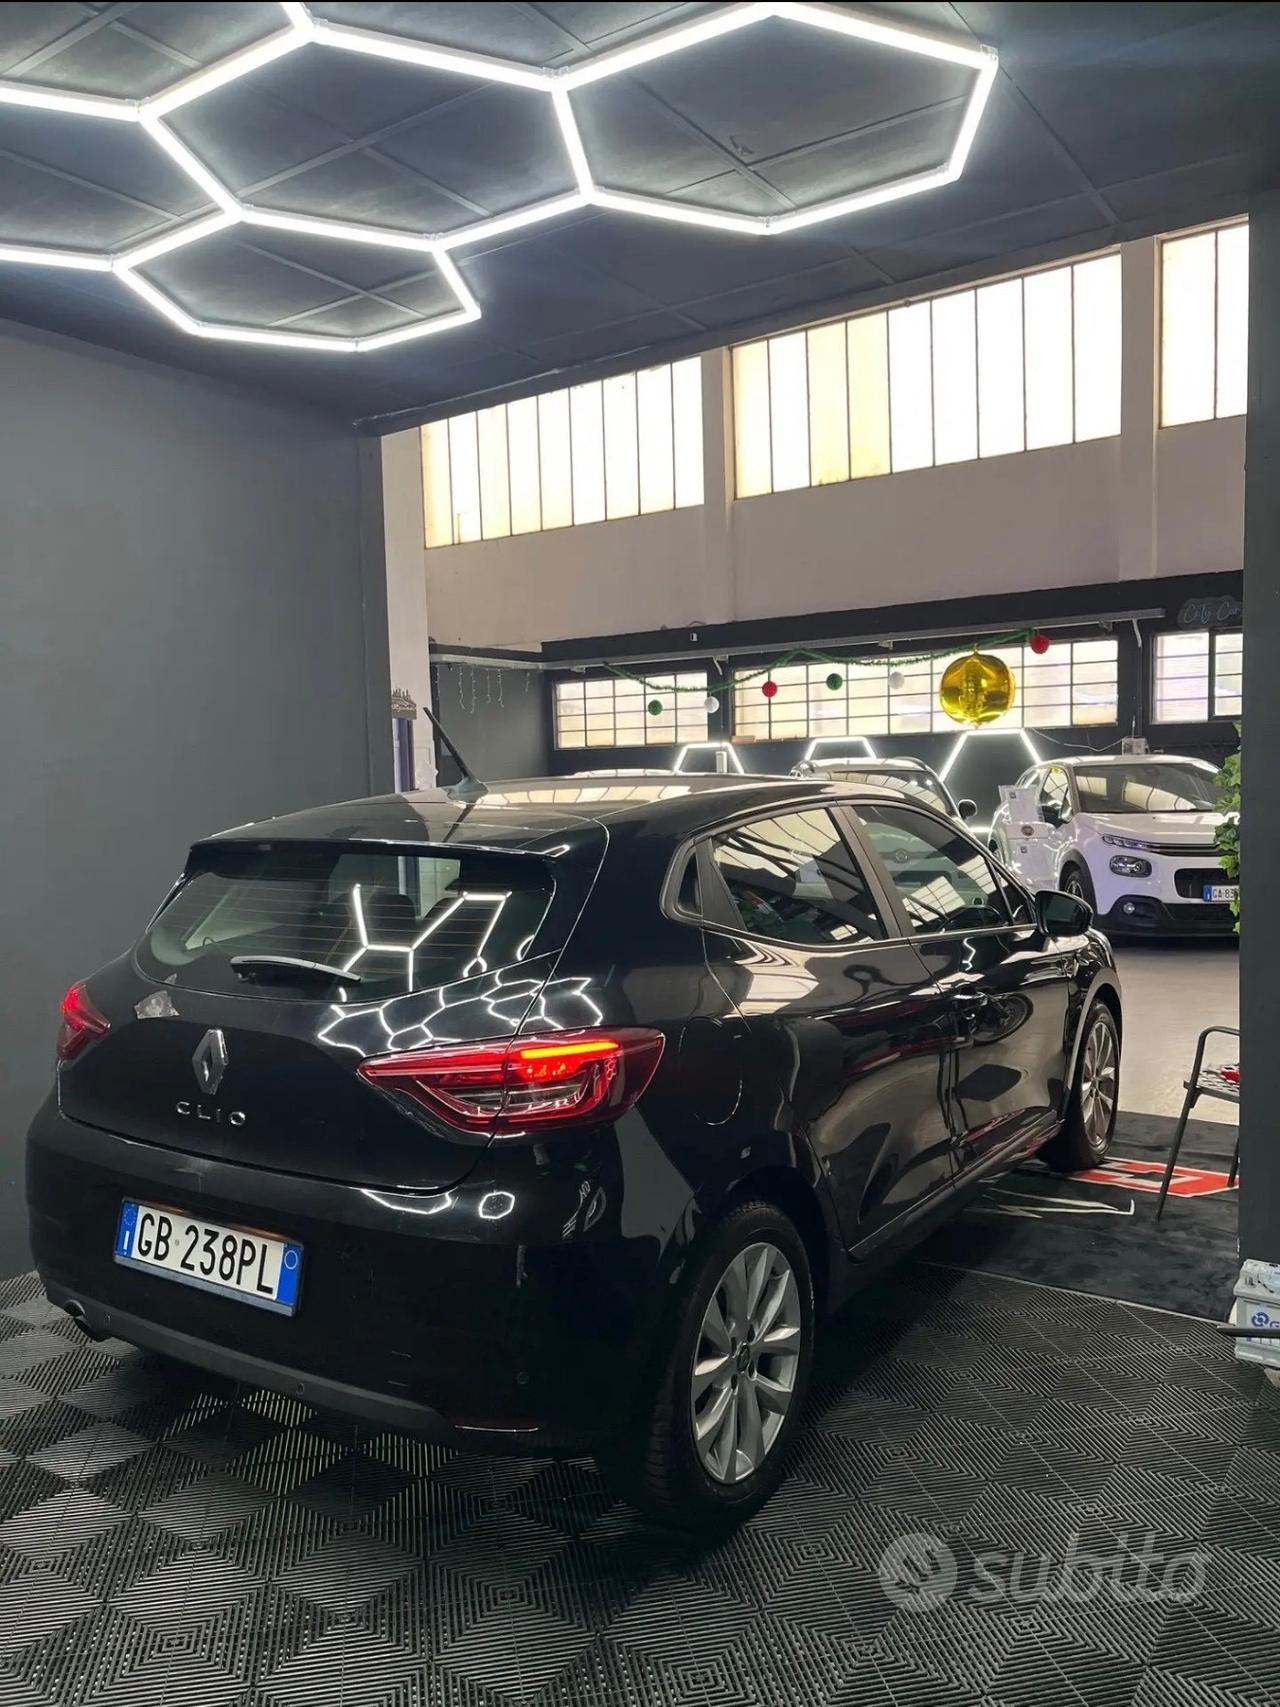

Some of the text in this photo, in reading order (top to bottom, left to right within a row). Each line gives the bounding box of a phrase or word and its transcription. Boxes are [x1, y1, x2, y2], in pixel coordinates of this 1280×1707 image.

[176, 1101, 246, 1126] CLIO
[137, 1213, 173, 1262] GB
[180, 1225, 274, 1295] 238PL
